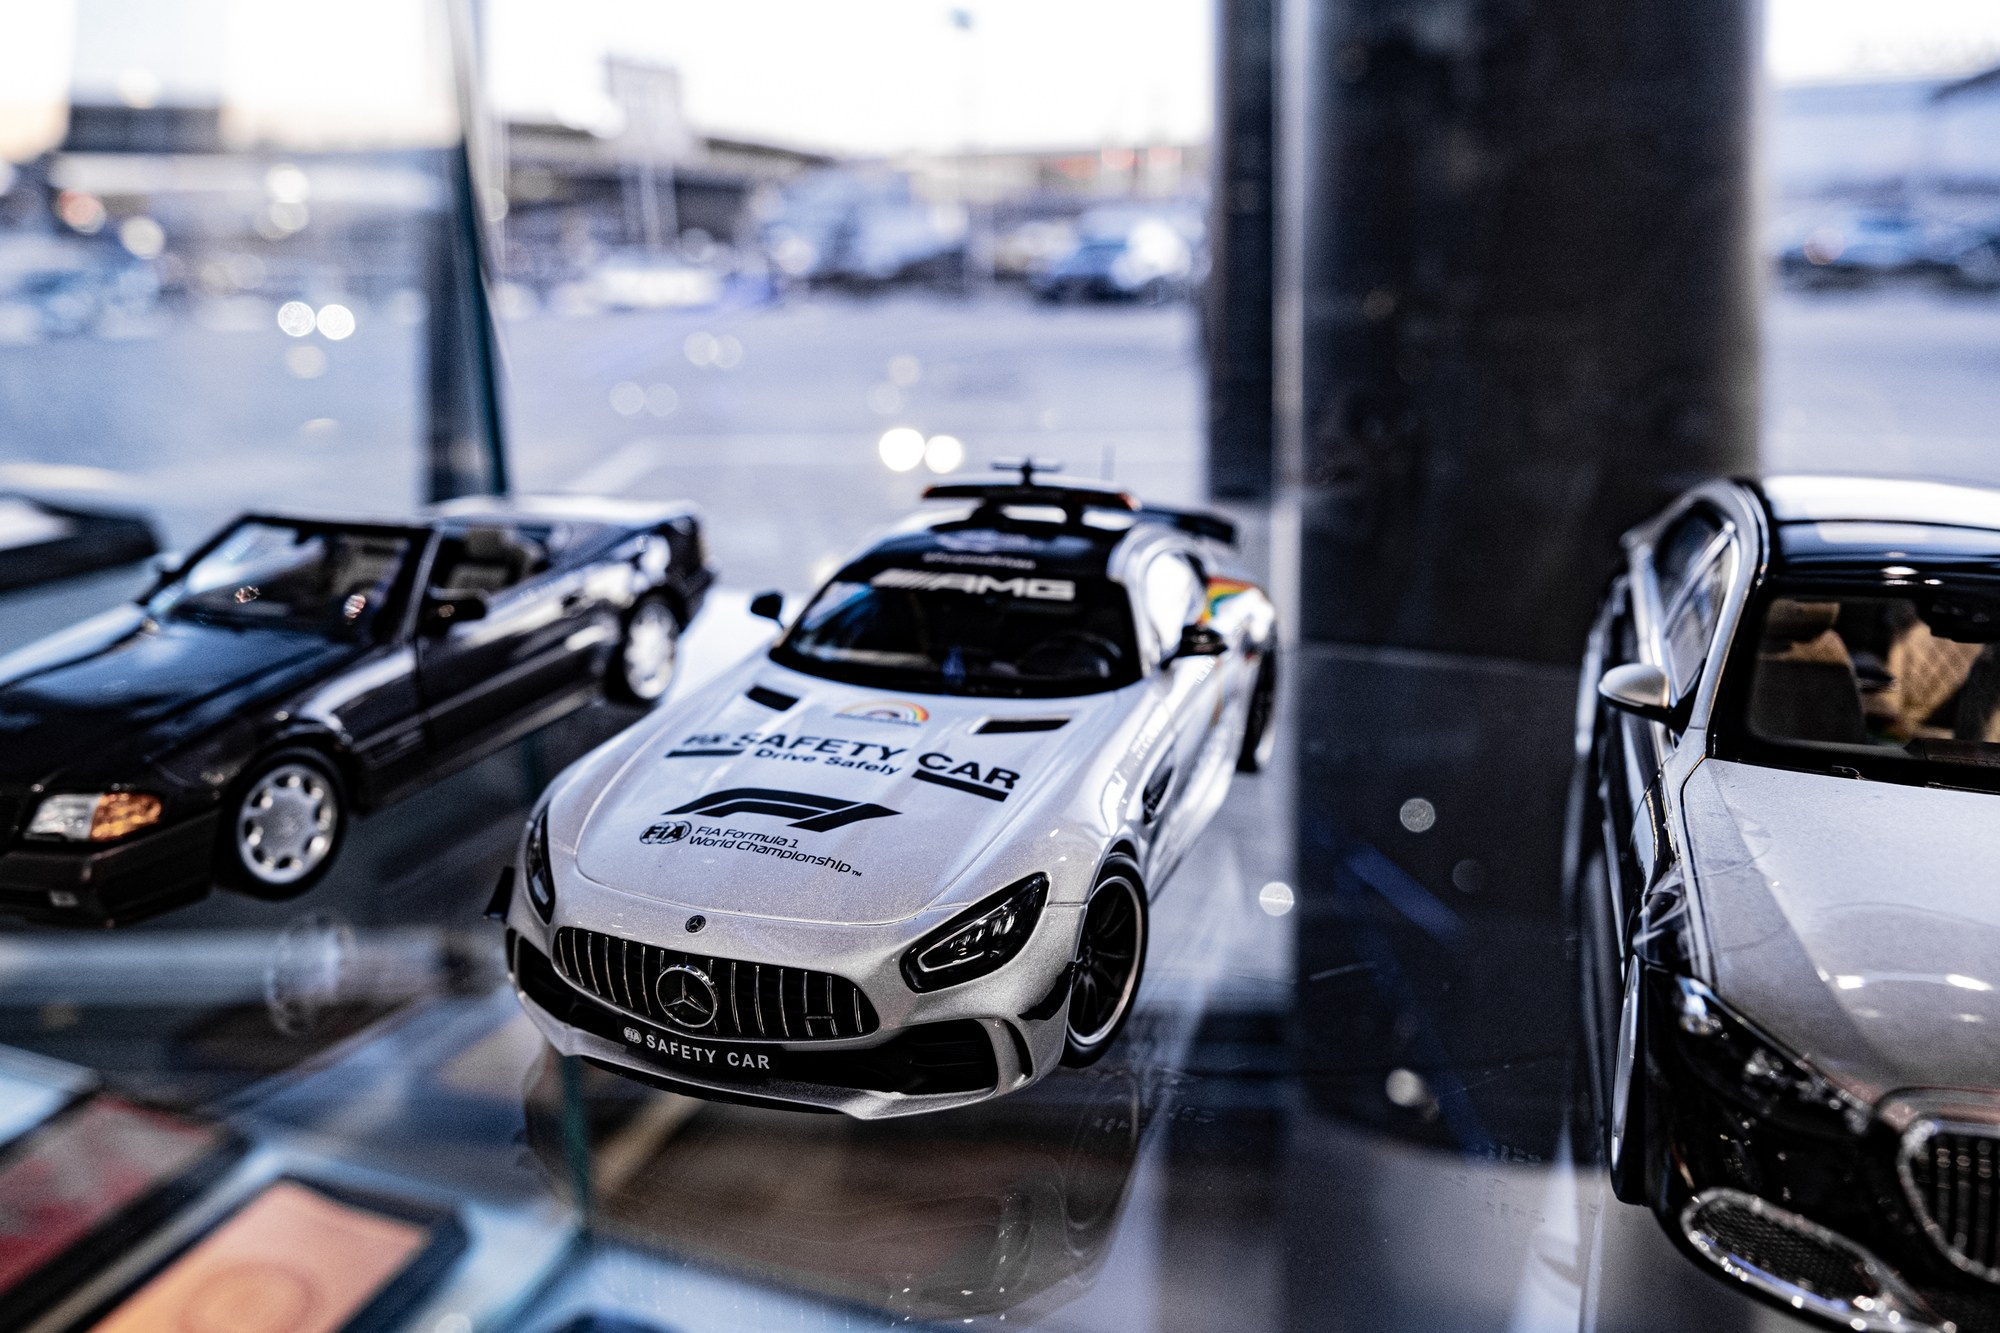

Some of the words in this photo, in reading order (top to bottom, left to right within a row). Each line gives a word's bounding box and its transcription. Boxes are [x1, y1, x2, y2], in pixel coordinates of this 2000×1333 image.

[730, 732, 908, 761] SAFETY
[917, 752, 1022, 790] CAR
[754, 748, 817, 763] Drive
[824, 756, 903, 776] Safely
[640, 822, 691, 843] FIA
[689, 834, 736, 850] World
[695, 825, 722, 837] FIA
[722, 828, 789, 847] Formula
[646, 1034, 716, 1063] SAFETY
[727, 1052, 770, 1070] CAR
